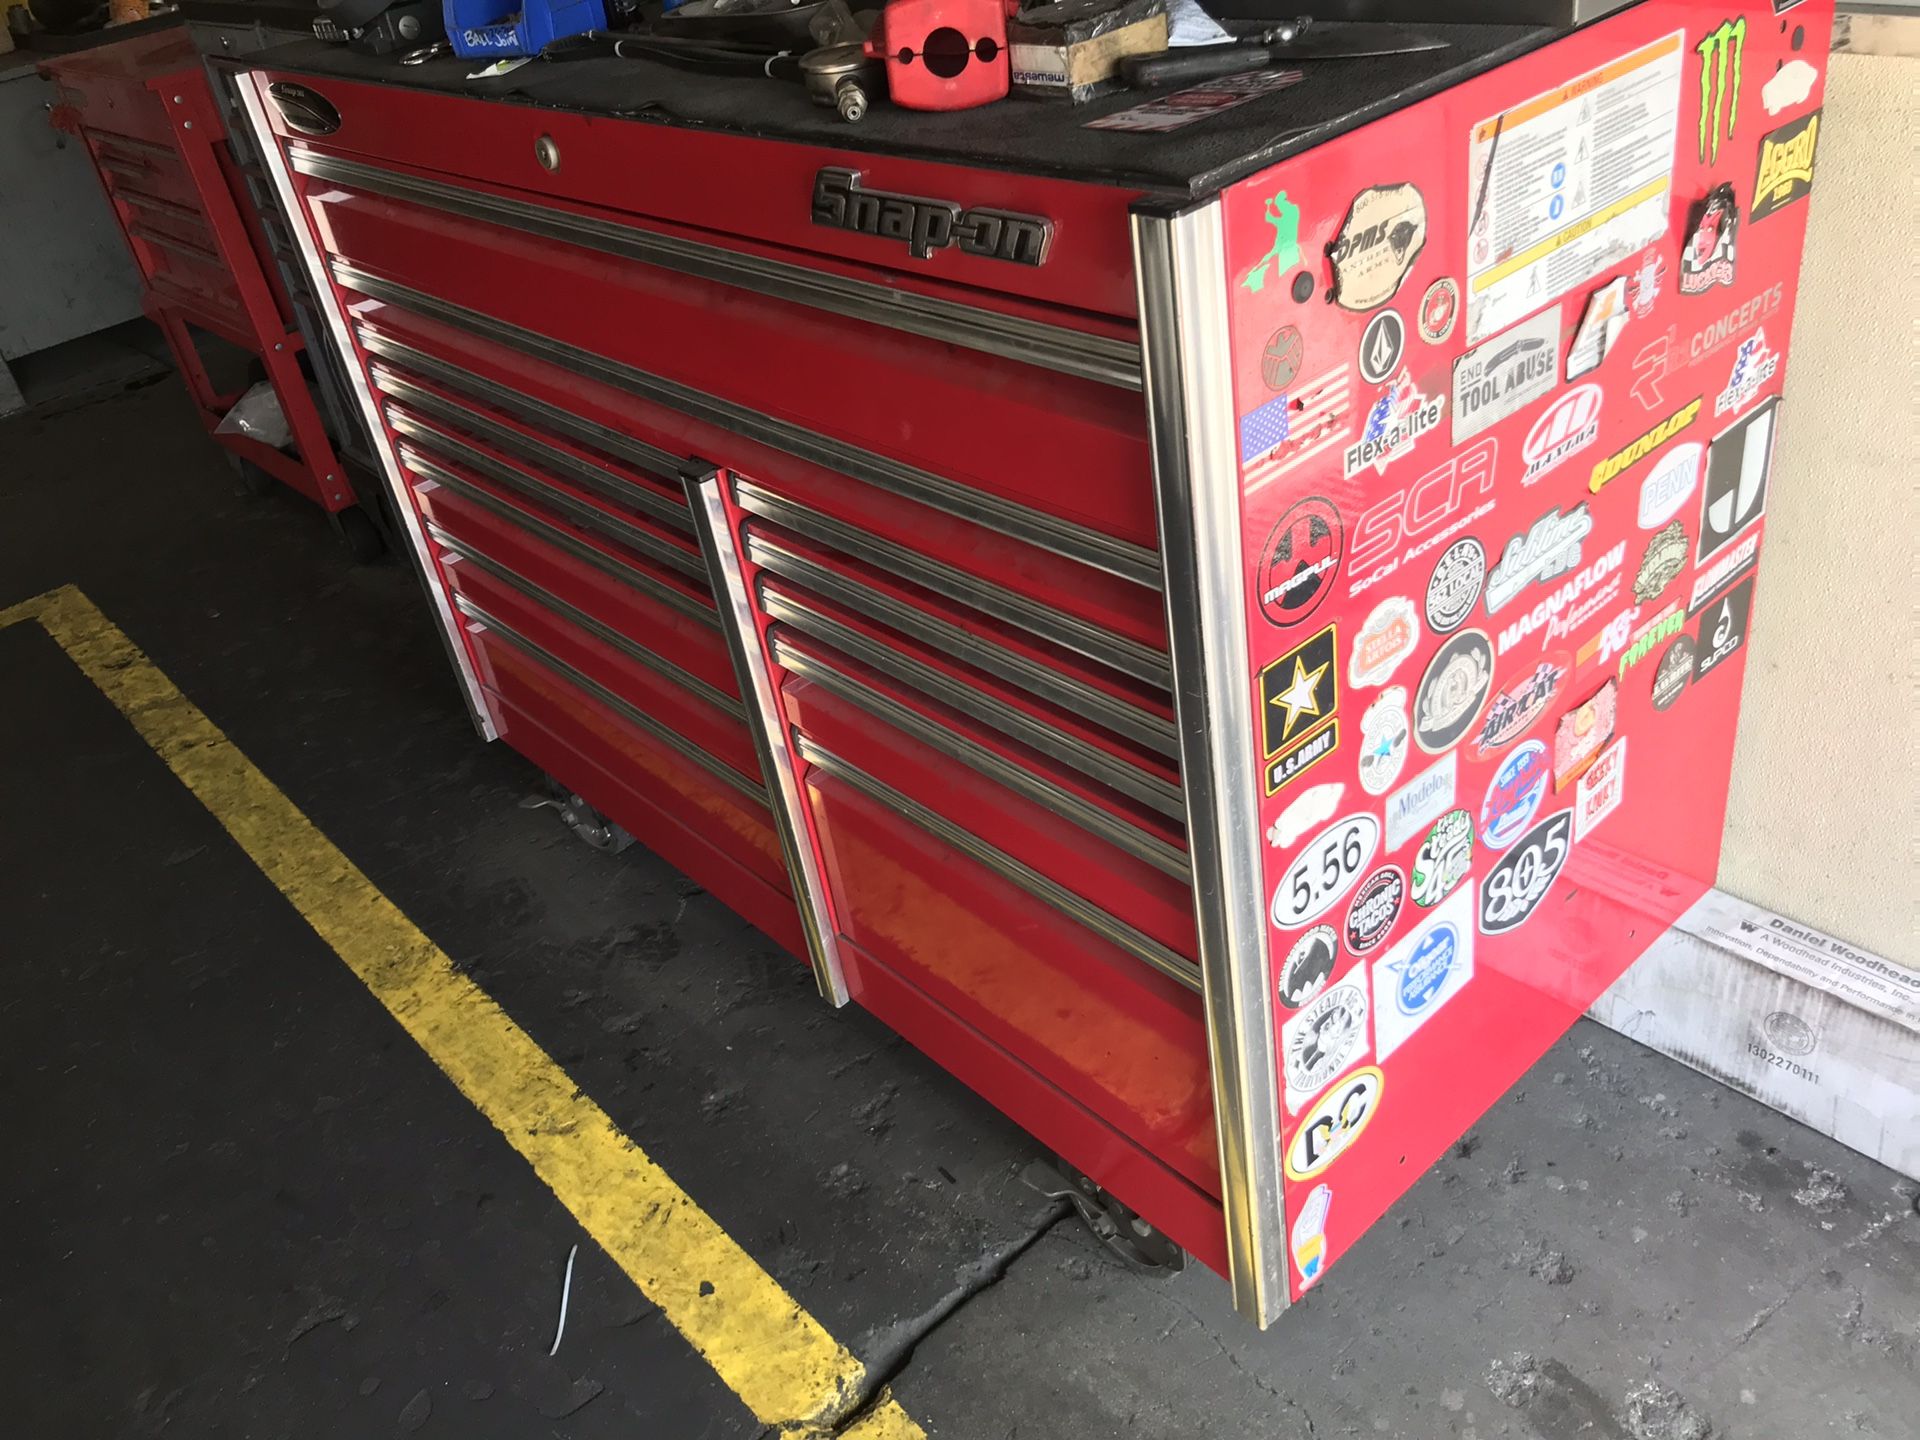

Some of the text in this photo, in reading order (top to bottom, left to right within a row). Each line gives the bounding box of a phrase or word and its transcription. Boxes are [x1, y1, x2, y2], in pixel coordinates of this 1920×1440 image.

[463, 30, 493, 47] BALL
[811, 167, 1055, 267] Snap-on
[1335, 218, 1390, 266] DPMS
[1563, 217, 1593, 243] CAUTION
[1690, 281, 1784, 359] CONCEPTS
[1460, 361, 1483, 386] END
[1460, 376, 1500, 418] TOOL
[1504, 348, 1555, 394] ABUSE
[1347, 403, 1439, 474] Flex-a-lite
[1598, 398, 1702, 486] DUNLOP
[1347, 437, 1498, 577] SCA
[1641, 453, 1697, 516] PENN
[1349, 557, 1399, 598] SoCal
[1402, 499, 1497, 564] Accessories
[1263, 555, 1339, 606] MAGPUL
[1449, 562, 1484, 600] LOCAL
[1498, 540, 1627, 656] MAGNAFLOW
[1365, 624, 1404, 653] STELLA
[1298, 731, 1331, 769] ARMY
[1398, 773, 1444, 818] Modelo
[1292, 826, 1362, 915] 5.56
[1485, 817, 1568, 922] 805
[1349, 877, 1401, 930] CHRONIC
[1356, 902, 1395, 937] TACOS
[1769, 917, 1828, 949] Daniel
[1755, 946, 1820, 979] Dependability
[1819, 974, 1839, 988] and
[1839, 983, 1904, 1016] Performance
[1760, 933, 1770, 942] A
[1772, 937, 1831, 967] Woodhead
[1830, 961, 1888, 993] Industries,
[1292, 1031, 1306, 1054] THE
[1305, 990, 1345, 1027] STEADY
[1746, 1042, 1820, 1085] 1302270111
